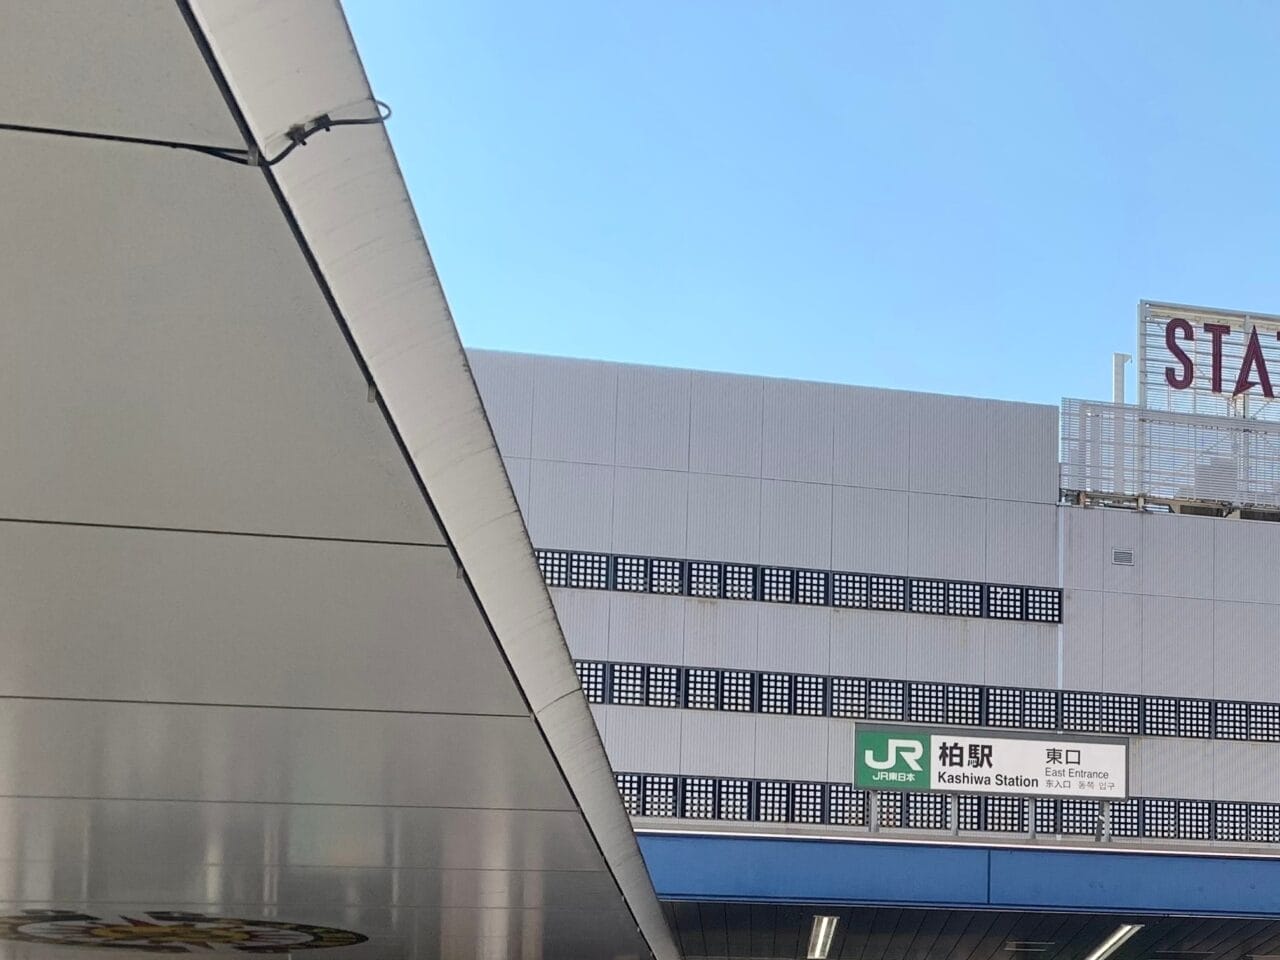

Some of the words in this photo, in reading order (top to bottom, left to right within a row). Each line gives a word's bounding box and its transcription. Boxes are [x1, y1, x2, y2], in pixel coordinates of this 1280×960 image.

[864, 738, 924, 771] JR
[939, 742, 993, 768] 柏駅
[1045, 747, 1081, 765] 東口
[872, 771, 916, 782] JR東日本
[938, 771, 991, 786] Kashiwa
[995, 774, 1039, 788] Station
[1045, 767, 1065, 777] East
[1068, 768, 1109, 779] Entrance
